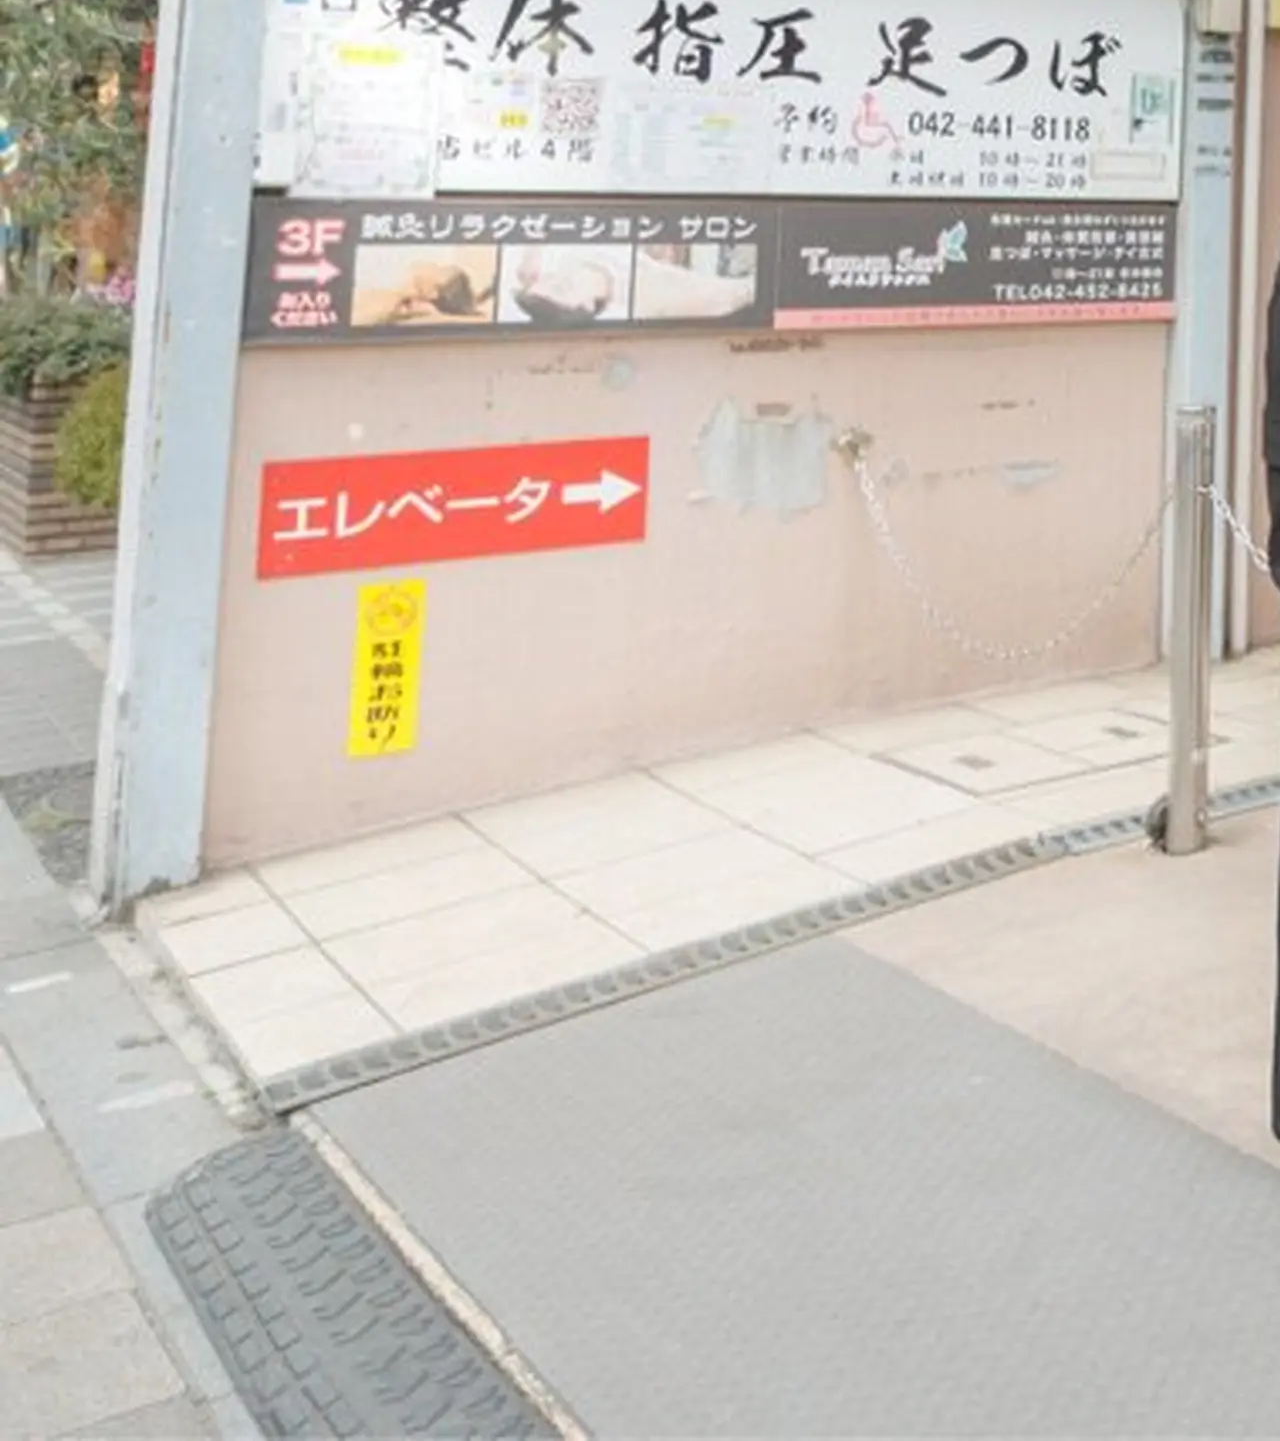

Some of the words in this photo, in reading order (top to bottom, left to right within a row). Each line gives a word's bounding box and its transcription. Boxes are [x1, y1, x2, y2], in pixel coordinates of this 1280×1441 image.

[866, 16, 1124, 98] 足つぼ
[275, 217, 346, 257] 3F
[272, 475, 552, 541] エレベータ
